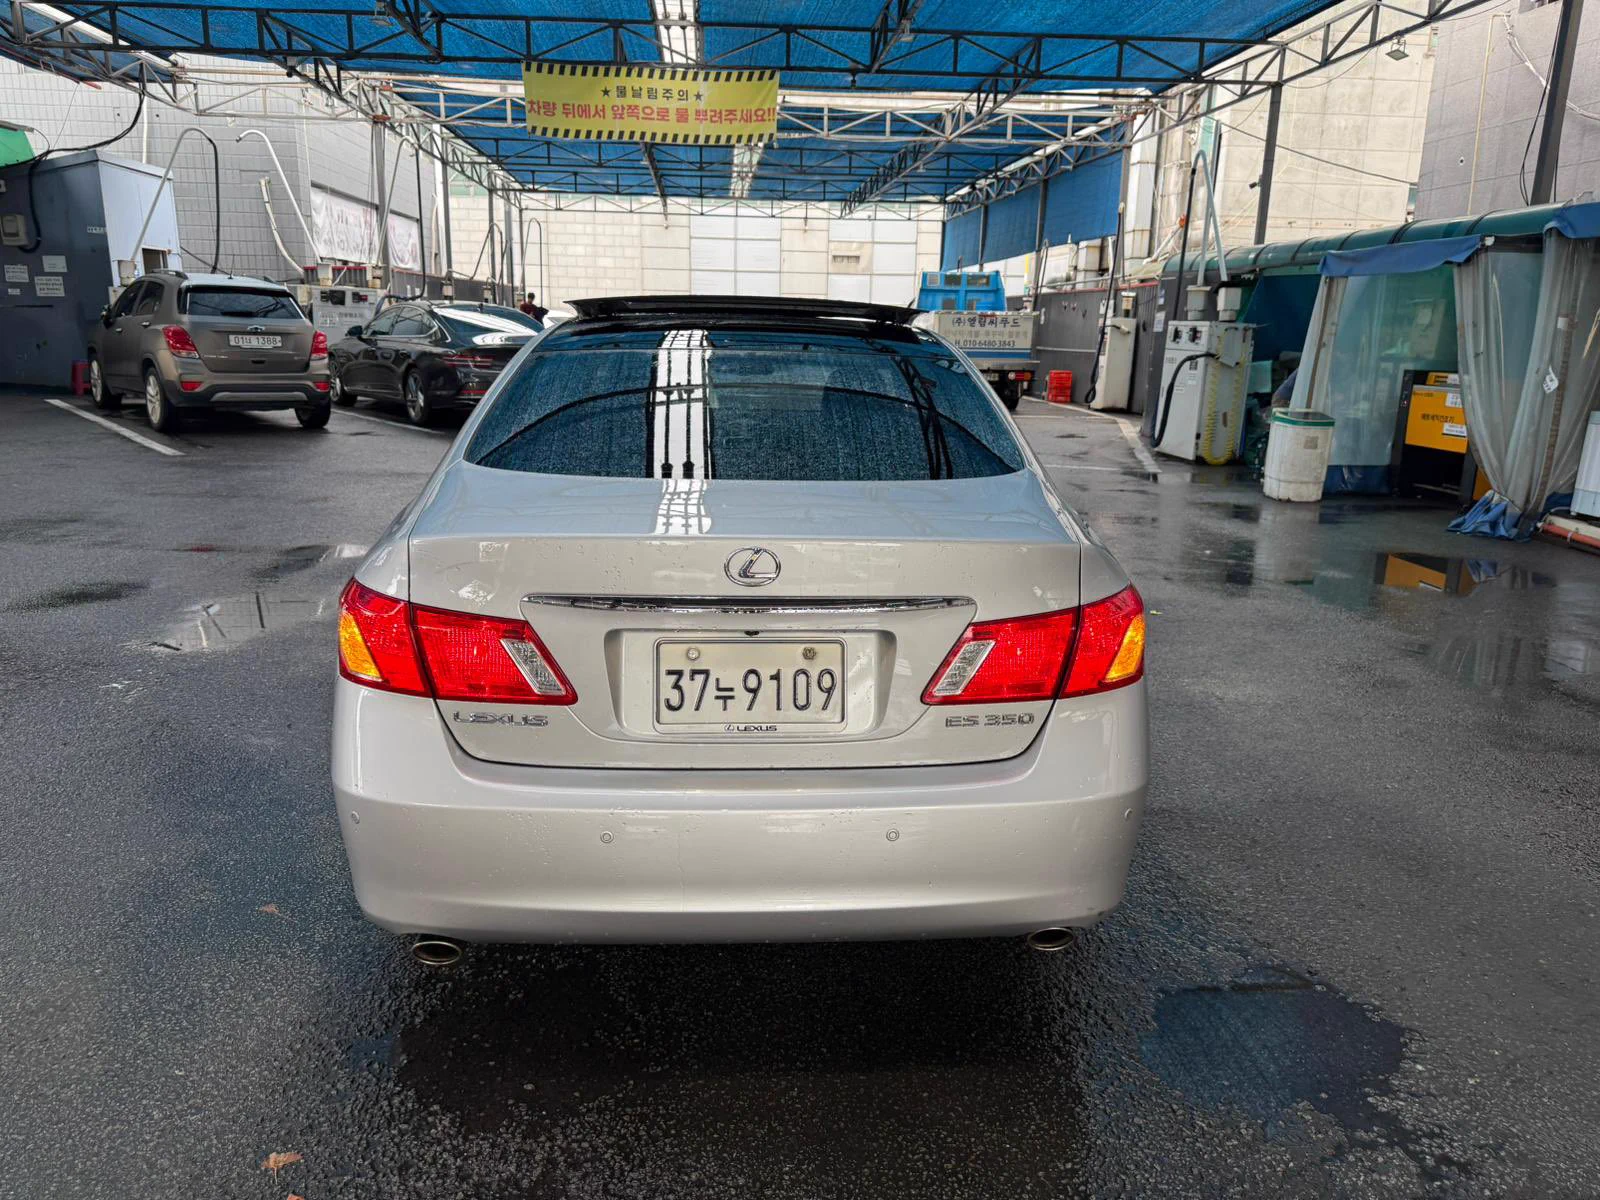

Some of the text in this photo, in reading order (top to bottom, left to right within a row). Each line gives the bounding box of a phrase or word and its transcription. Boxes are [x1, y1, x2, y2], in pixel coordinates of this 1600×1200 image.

[528, 98, 775, 124] 차량 뒤에서 앞쪽으로 물 뿌려주세요!!
[256, 336, 278, 346] 1388
[453, 711, 548, 726] LEXUS
[945, 712, 1035, 727] ES 350
[736, 723, 777, 732] LEXUS
